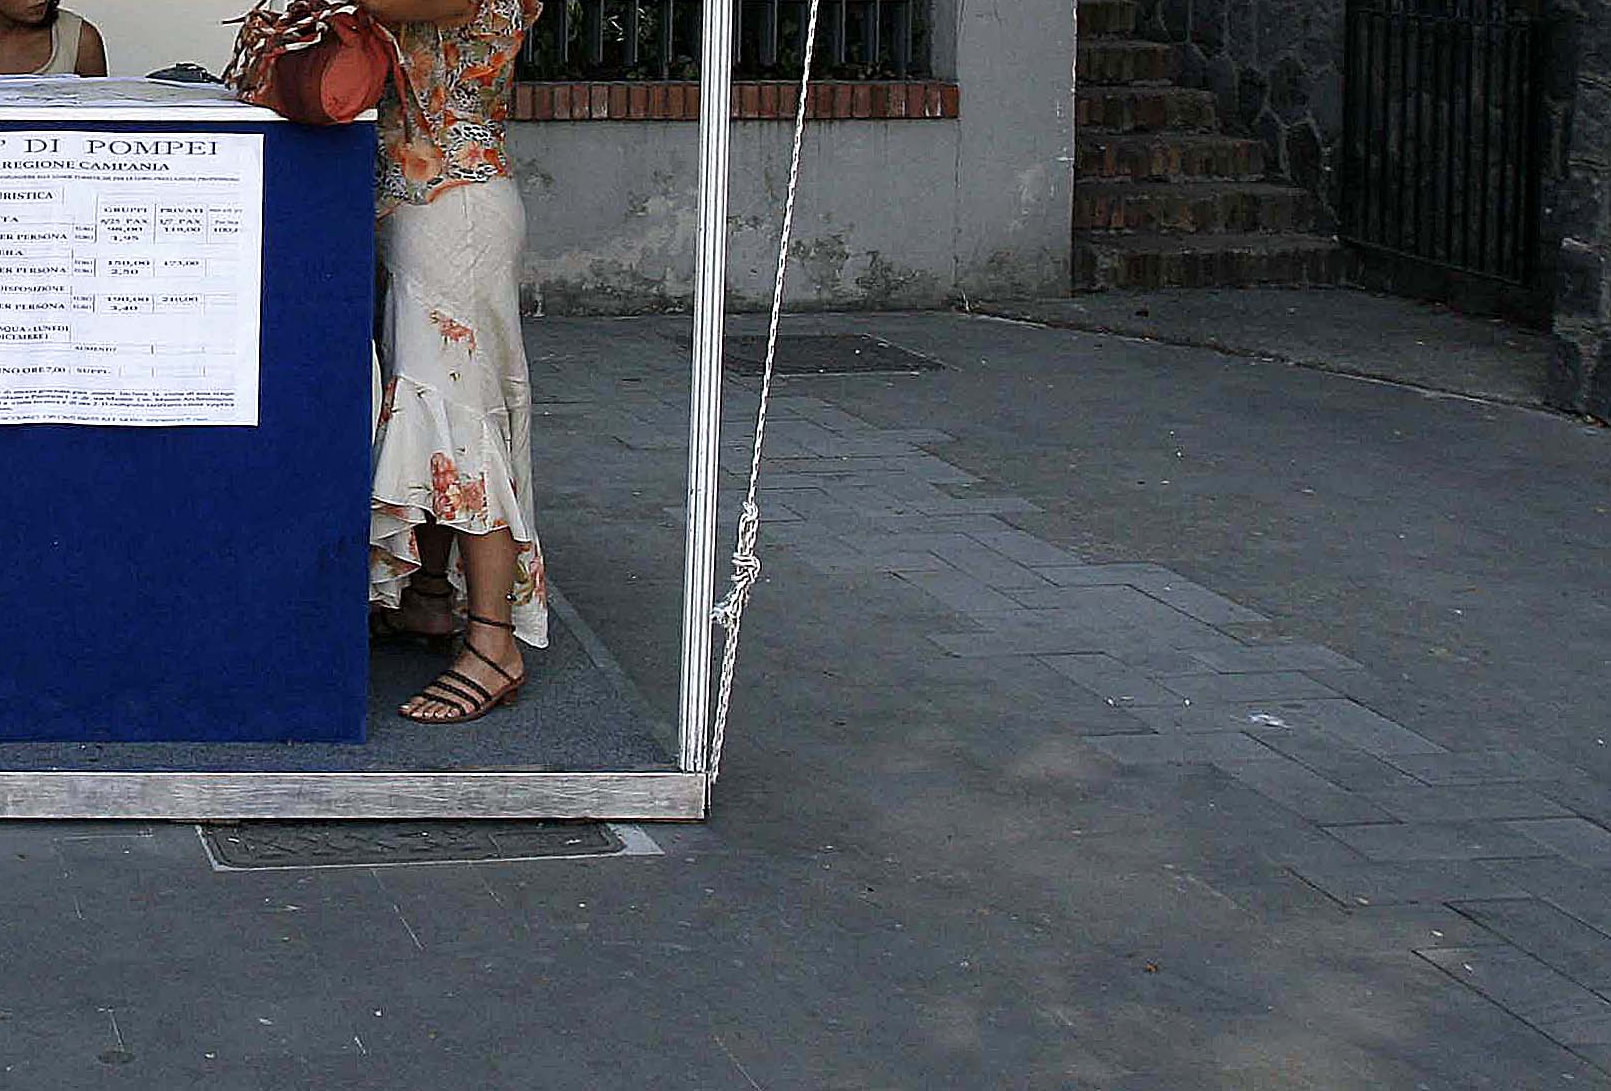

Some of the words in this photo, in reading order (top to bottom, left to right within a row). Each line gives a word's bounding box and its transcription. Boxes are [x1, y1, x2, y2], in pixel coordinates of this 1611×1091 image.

[23, 138, 61, 153] DI
[86, 139, 219, 156] POMPEI
[2, 160, 75, 170] REGIONE
[79, 161, 170, 171] CAMPANIA
[16, 233, 68, 241] PERSONA
[16, 266, 67, 274] PERSONA
[15, 303, 65, 311] PERSONA
